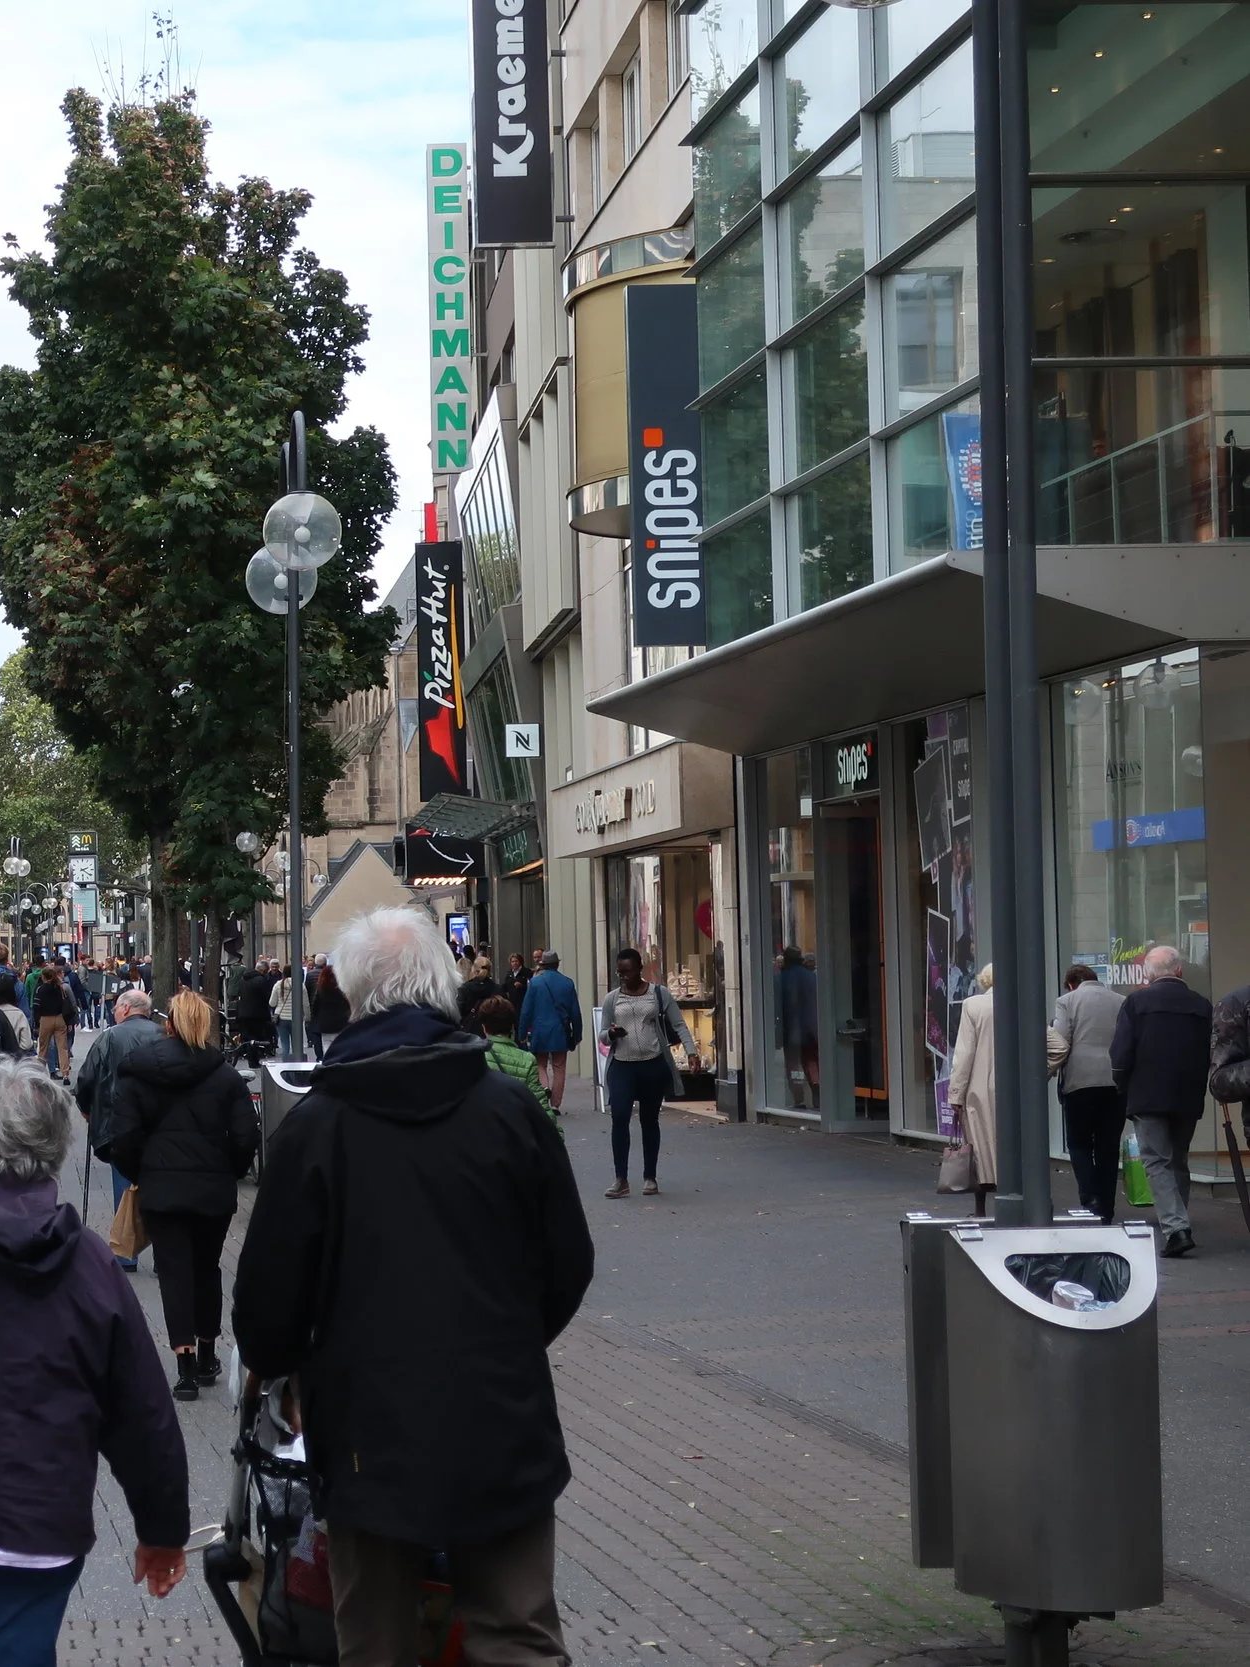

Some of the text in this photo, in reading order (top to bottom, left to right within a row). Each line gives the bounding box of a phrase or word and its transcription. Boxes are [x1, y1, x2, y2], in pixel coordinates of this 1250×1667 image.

[432, 148, 469, 468] DEICHMANN
[643, 449, 703, 609] snipes
[420, 557, 456, 709] Pizza Hut
[837, 743, 868, 790] snipes
